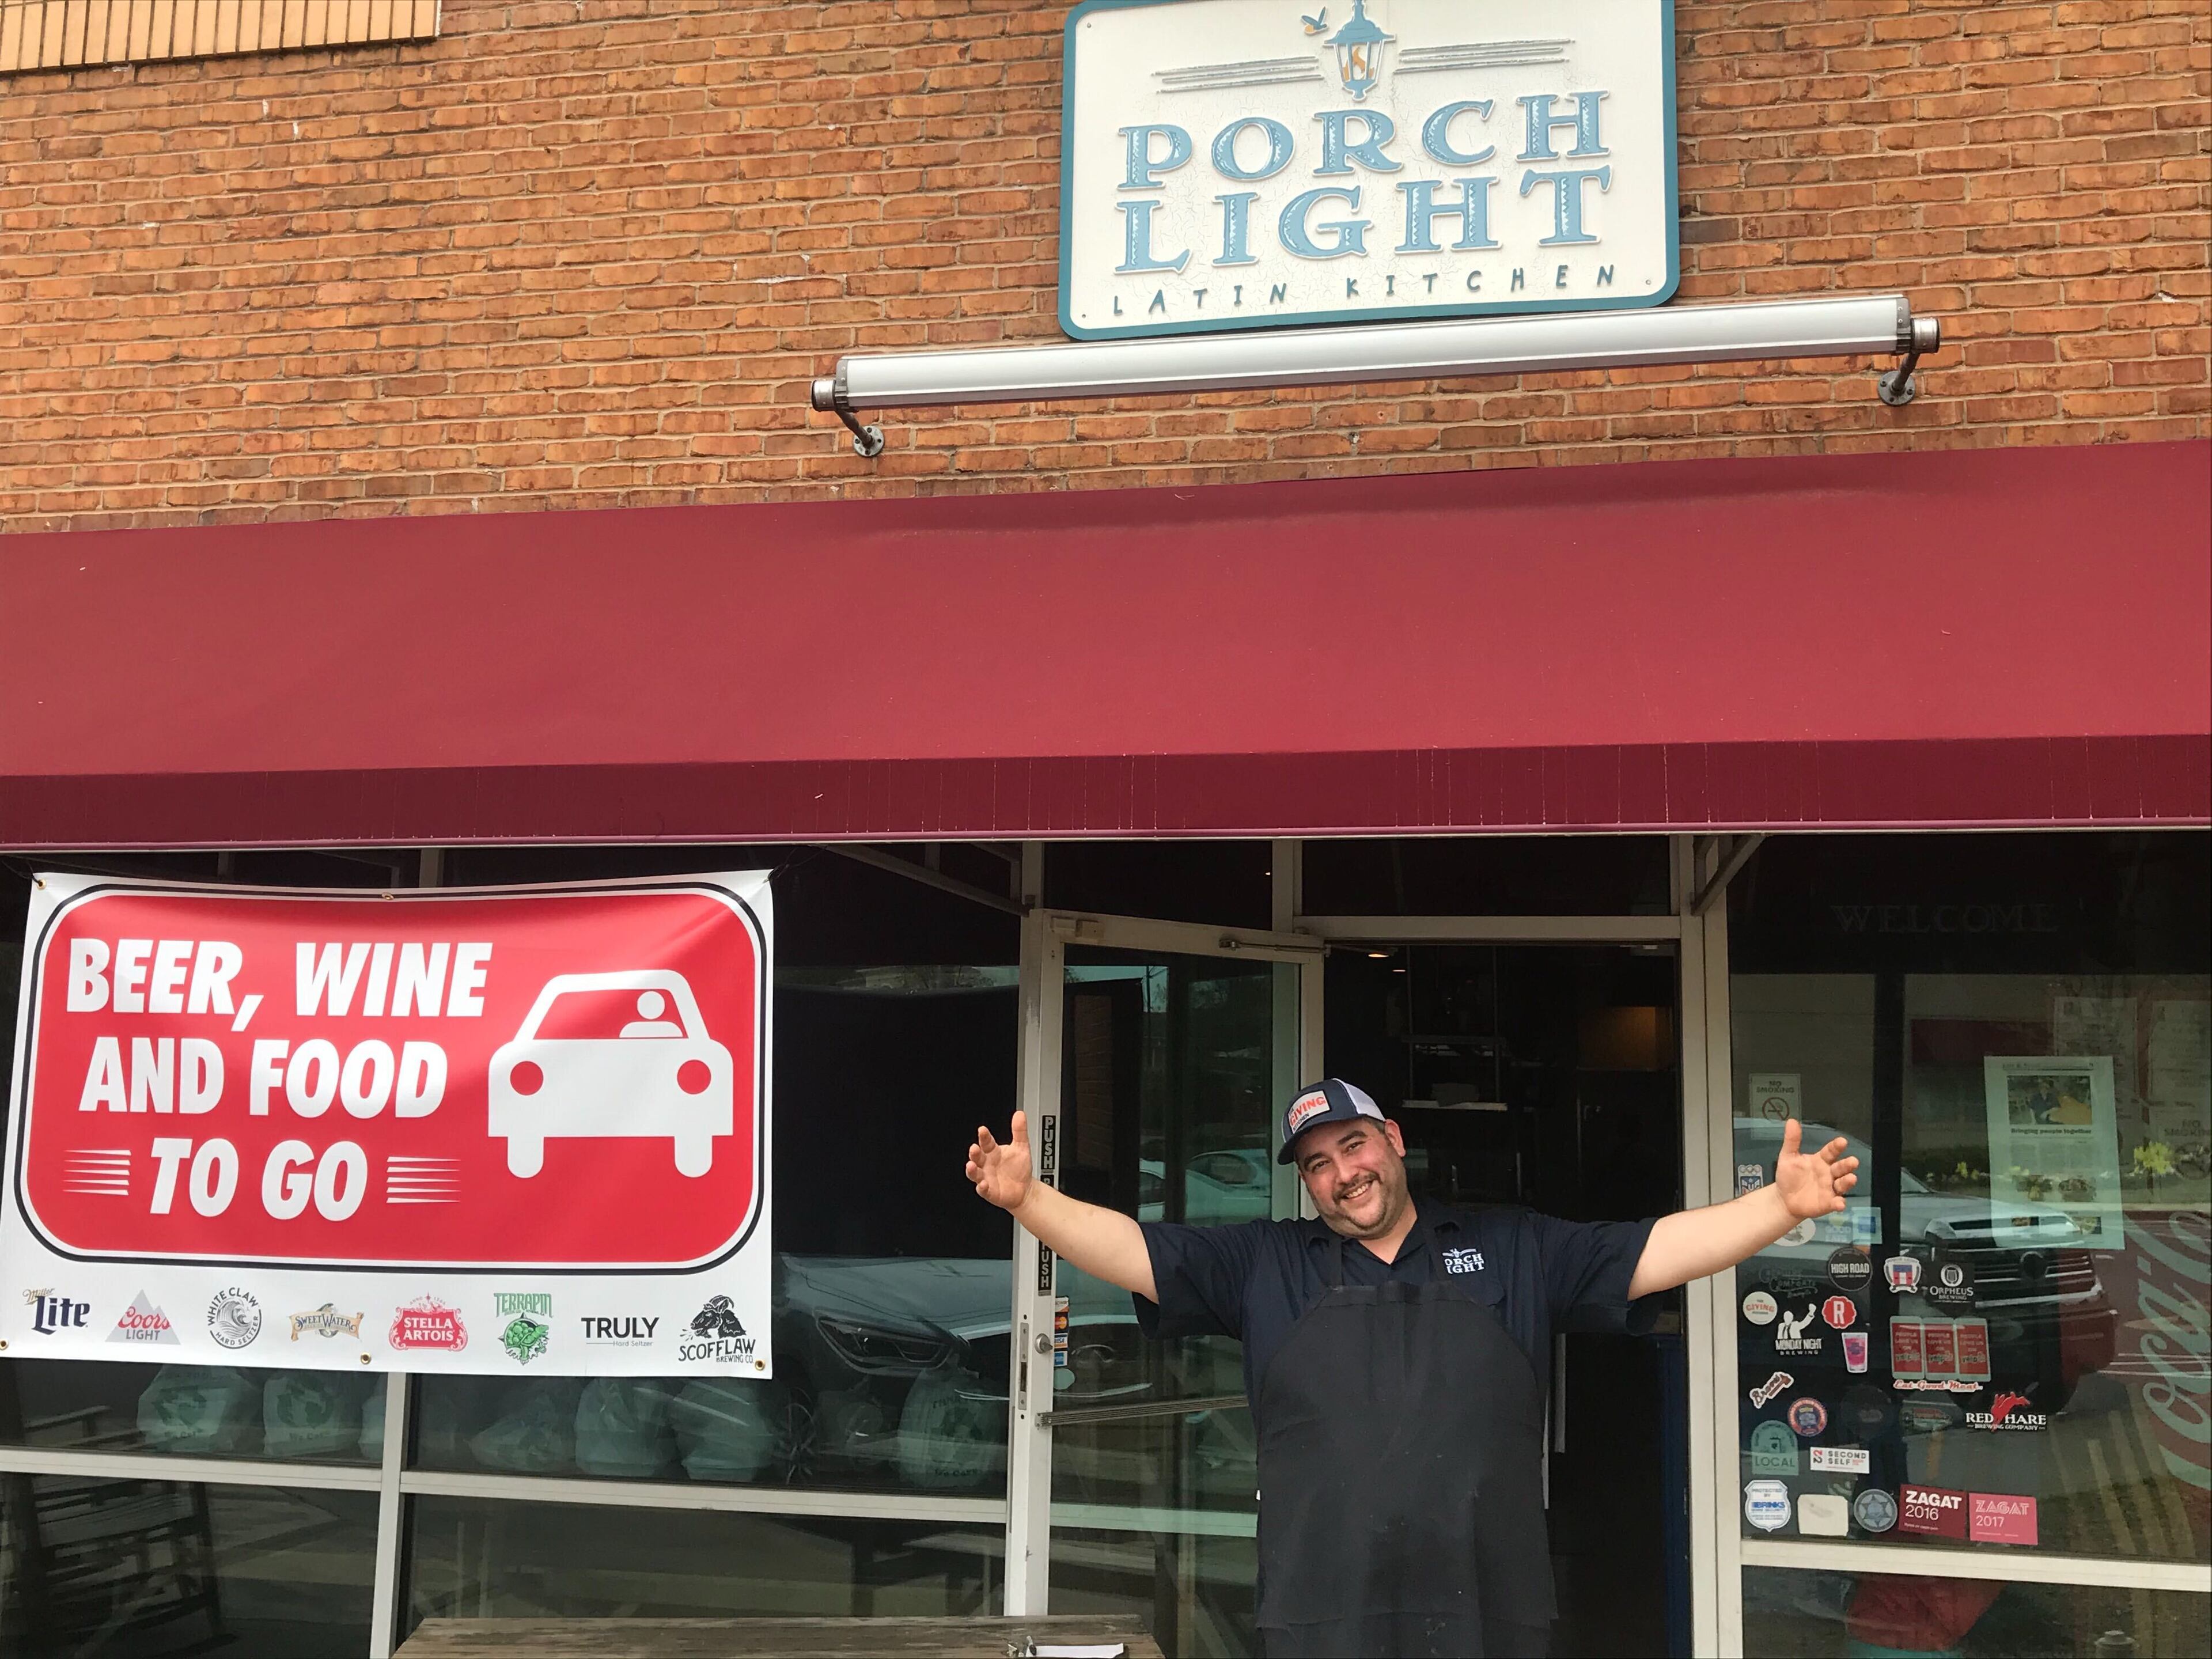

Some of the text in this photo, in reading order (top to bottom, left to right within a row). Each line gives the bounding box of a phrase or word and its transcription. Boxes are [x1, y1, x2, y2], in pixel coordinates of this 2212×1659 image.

[1116, 90, 1611, 191] PORCH
[1114, 164, 1612, 275] LIGHT
[1113, 264, 1615, 315] LATIN KITCHEN
[1830, 903, 2058, 933] WELCOME
[66, 937, 493, 1032] BEER, WINE
[78, 1037, 448, 1119] AND FOOD
[1290, 1096, 1326, 1126] GIVING
[1043, 1116, 1054, 1169] PUSH
[150, 1138, 368, 1222] TO GO
[1444, 1253, 1483, 1266] ORCH
[1446, 1260, 1484, 1275] IGHT
[1831, 1263, 1870, 1274] HIGH ROAD
[22, 1287, 56, 1306] Miller
[1930, 1285, 1974, 1297] ORPHEUS
[207, 1287, 259, 1326] WHITE CLAW
[493, 1292, 553, 1319] TERRAPIN
[1745, 1303, 1775, 1312] GIVING
[1832, 1300, 1845, 1324] R
[31, 1296, 90, 1335] Lite
[117, 1305, 172, 1330] Coors
[403, 1317, 454, 1329] STELLA
[126, 1330, 160, 1341] LIGHT
[215, 1315, 259, 1346] HARD SELTZER
[403, 1330, 454, 1342] ARTOIS
[581, 1317, 660, 1339] TRULY
[678, 1338, 756, 1362] SCOFFLAW
[1775, 1338, 1823, 1350] MONDAY NIGHT
[716, 1355, 755, 1364] BREWING CO.
[1917, 1380, 1945, 1390] Good
[1965, 1412, 2047, 1425] RED HARE
[1755, 1455, 1796, 1468] LOCAL
[1828, 1450, 1866, 1459] SECOND
[1906, 1490, 1963, 1510] ZAGAT
[1975, 1499, 2030, 1516] ZAGAT
[1904, 1504, 1939, 1521] 2016
[1976, 1515, 2005, 1528] 2017
